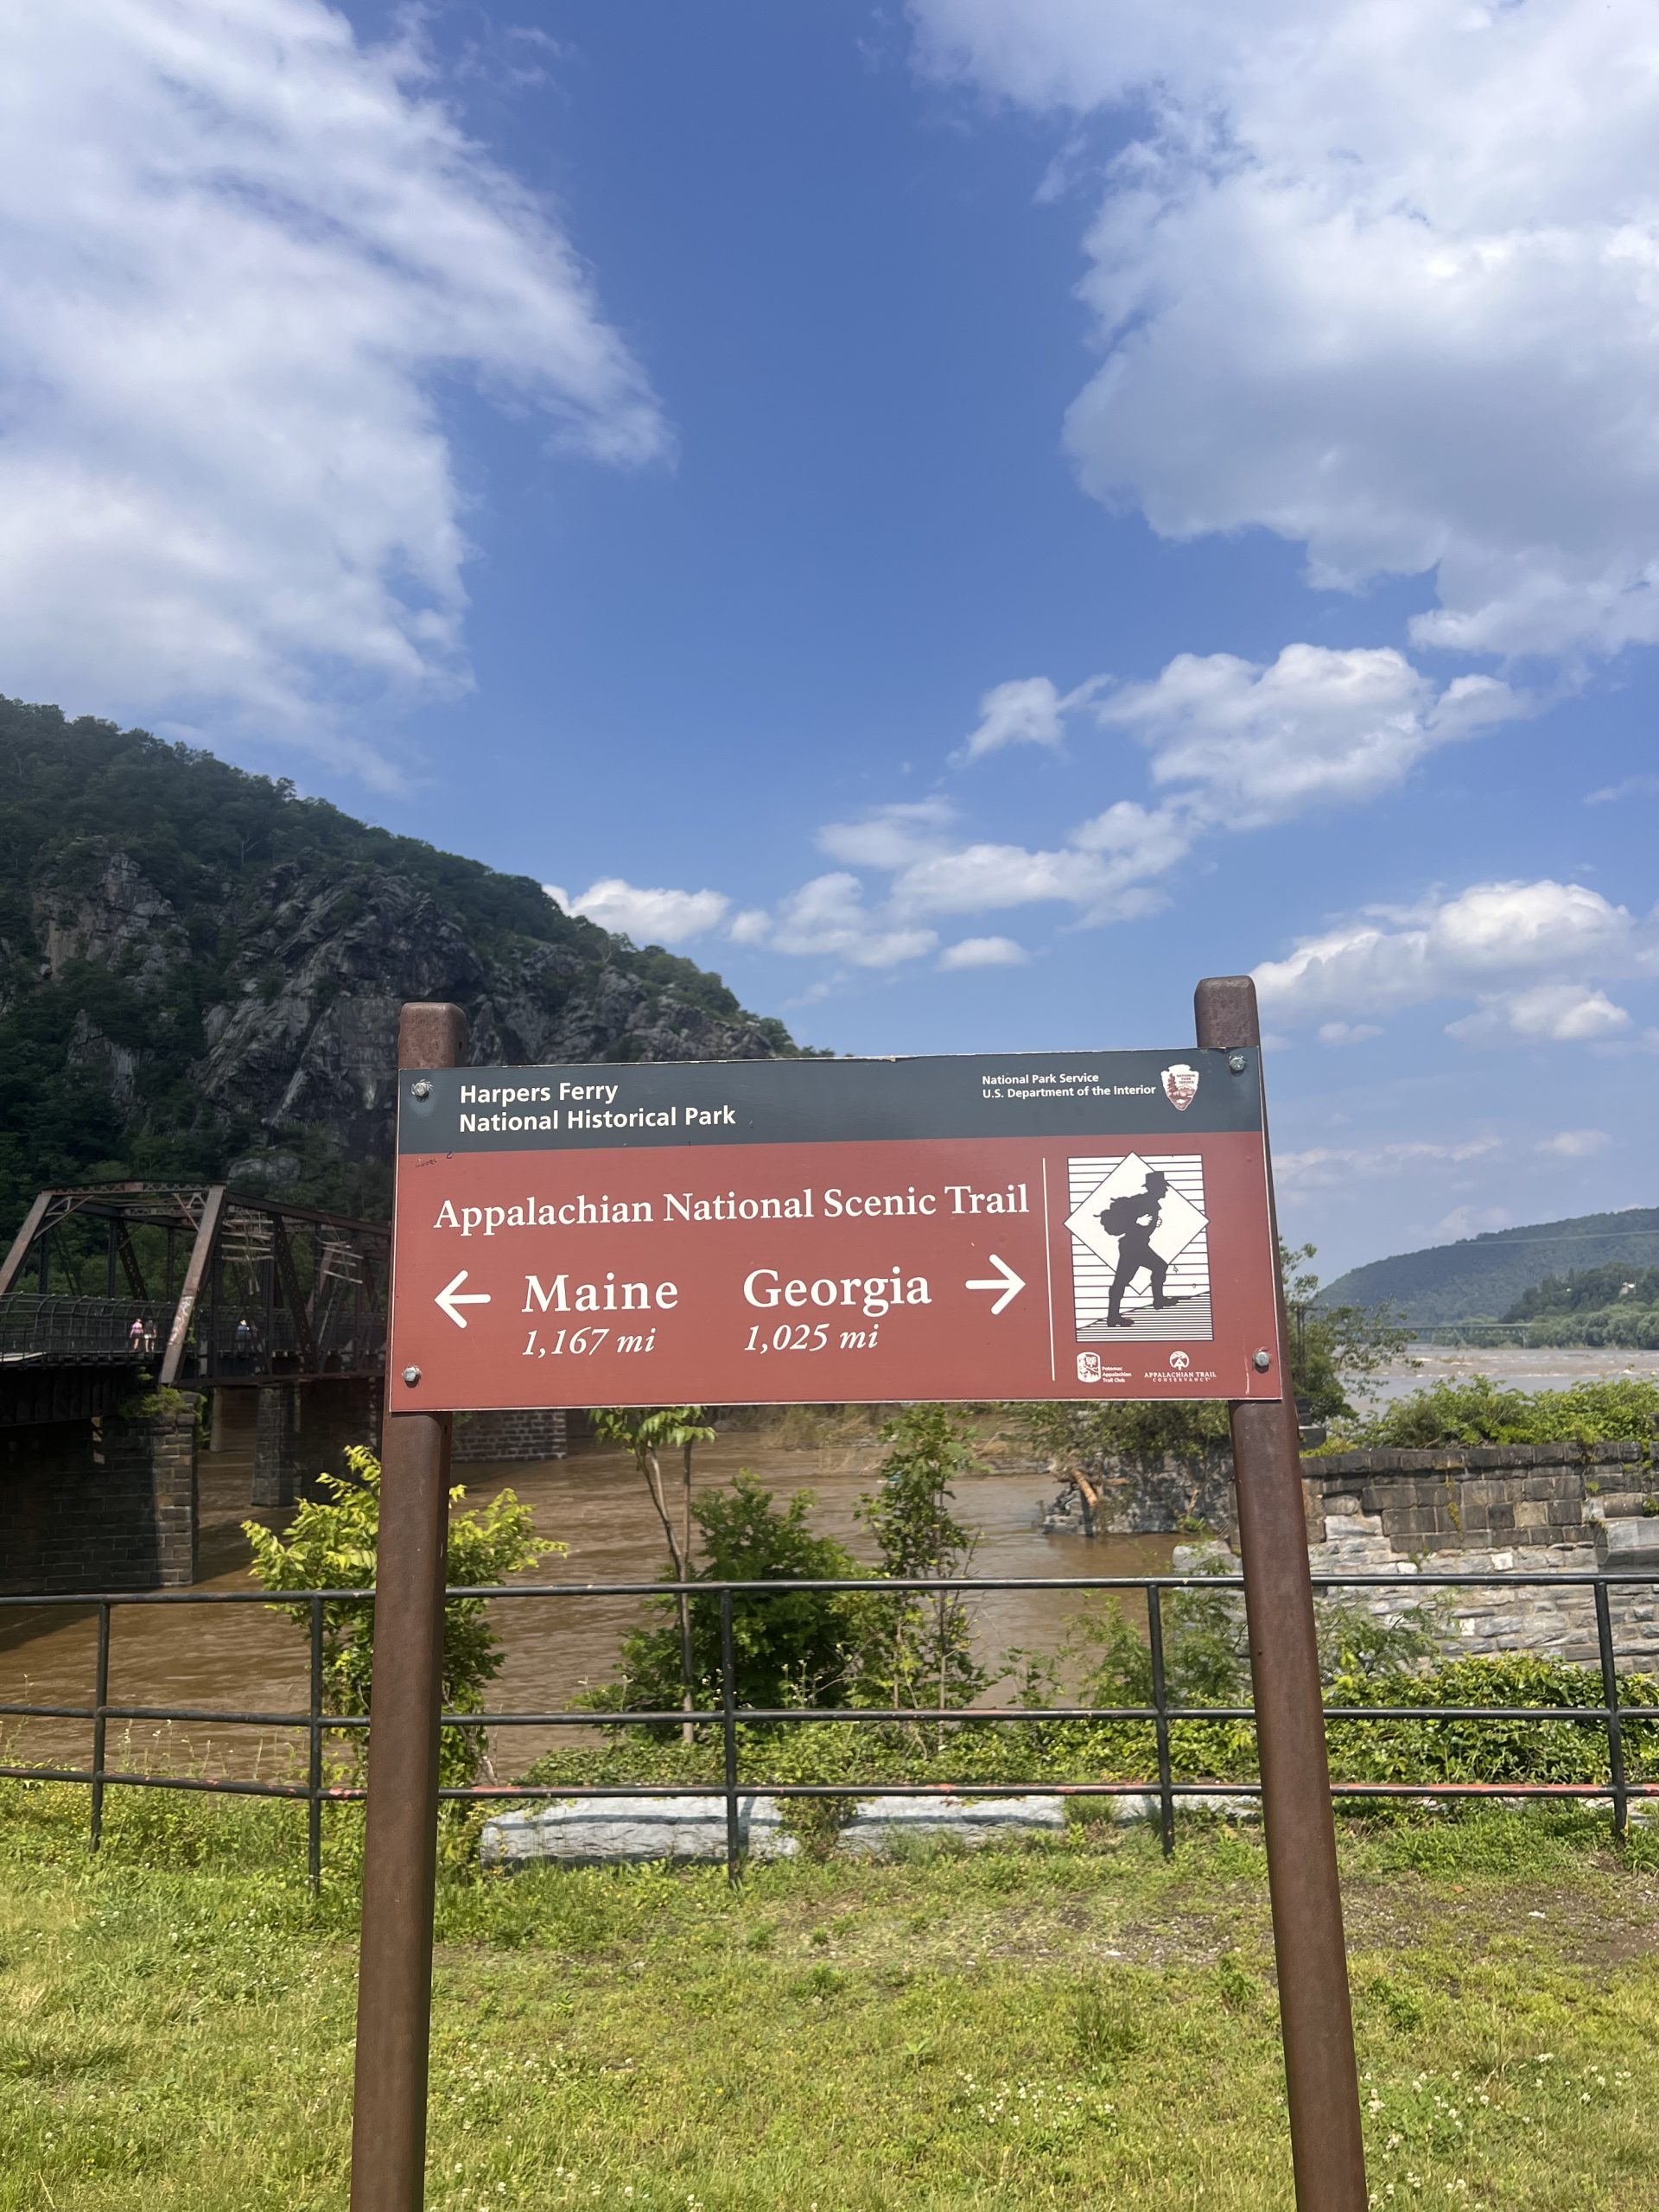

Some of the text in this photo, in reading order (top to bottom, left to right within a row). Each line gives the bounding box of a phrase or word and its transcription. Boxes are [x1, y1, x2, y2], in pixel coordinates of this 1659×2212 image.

[461, 1082, 619, 1107] Harpers Ferry
[982, 1072, 1099, 1085] National Park Service
[982, 1084, 1156, 1100] U.S. Department of the Interior
[460, 1104, 736, 1133] National Historical Park
[433, 1183, 1030, 1236] Appalachian National Scenic Trail
[521, 1272, 678, 1313] Maine
[743, 1266, 932, 1318] Georgia
[522, 1326, 657, 1358] 1,167 mi
[744, 1323, 880, 1355] 1,025 mi
